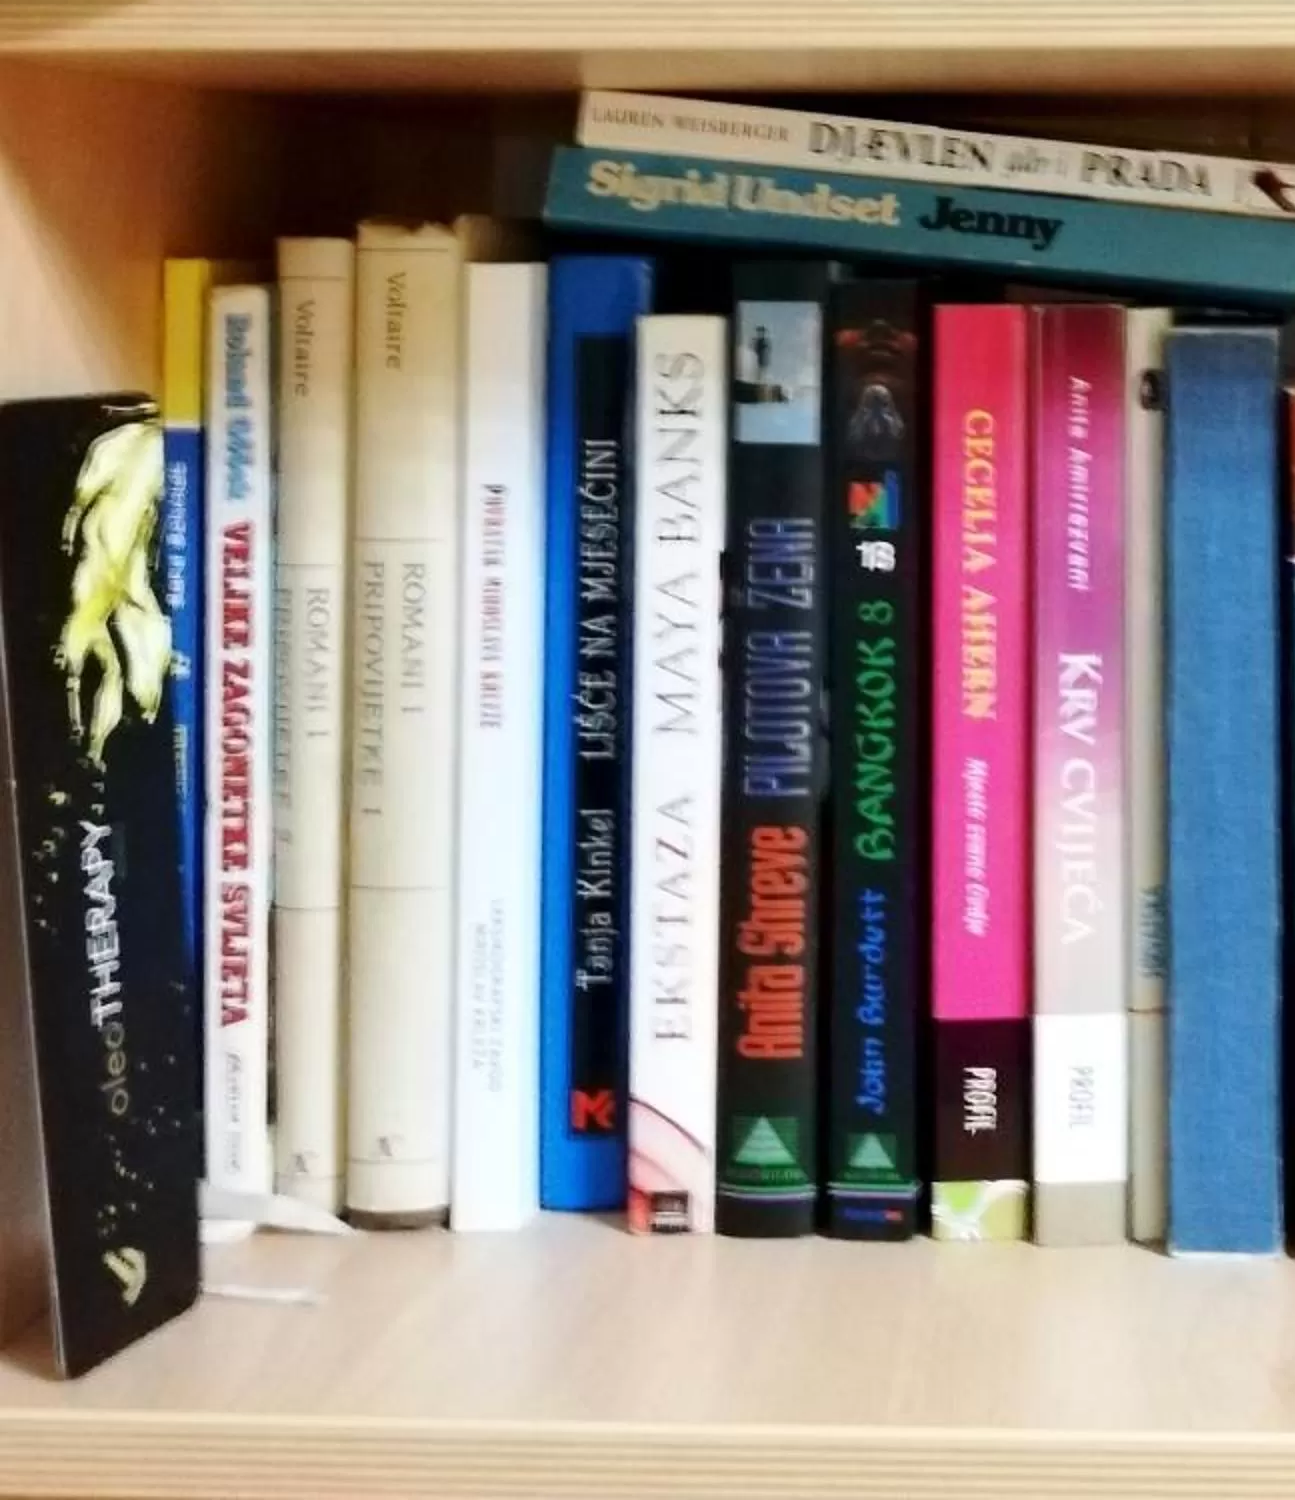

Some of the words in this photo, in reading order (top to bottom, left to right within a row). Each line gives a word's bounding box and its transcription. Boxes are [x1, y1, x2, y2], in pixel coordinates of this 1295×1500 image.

[590, 106, 665, 129] LAUREN
[586, 158, 730, 213] Sigrid
[730, 174, 901, 227] Undset
[919, 193, 1064, 251] Jenny
[1078, 150, 1215, 198] PRADA
[292, 298, 316, 399] Voltaire
[384, 271, 407, 370] Voltaire
[654, 350, 706, 547] BANKS
[1067, 375, 1093, 439] Anita
[962, 409, 997, 572] CECELIA
[306, 586, 331, 713] ROMANI
[401, 561, 426, 689] ROMANI
[579, 612, 617, 663] NA
[652, 571, 699, 736] MAYA
[857, 600, 895, 624] 8
[962, 584, 998, 721] AHERN
[360, 560, 386, 786] PRIPOVIJETKE
[742, 631, 812, 797] PILOTOVA
[1058, 651, 1104, 746] KRV
[220, 657, 256, 874] ZAGONETKE
[855, 635, 896, 861] BANGKOK
[576, 807, 615, 899] Kinkel
[736, 823, 809, 957] Shreve
[1055, 758, 1103, 946] CVIJEĆA
[576, 910, 621, 990] Tanja
[654, 794, 697, 1042] EKSTAZA
[737, 964, 805, 1059] Anita
[854, 1036, 886, 1117] John
[963, 1066, 998, 1137] PROFIL
[1067, 1065, 1096, 1132] PROFIL
